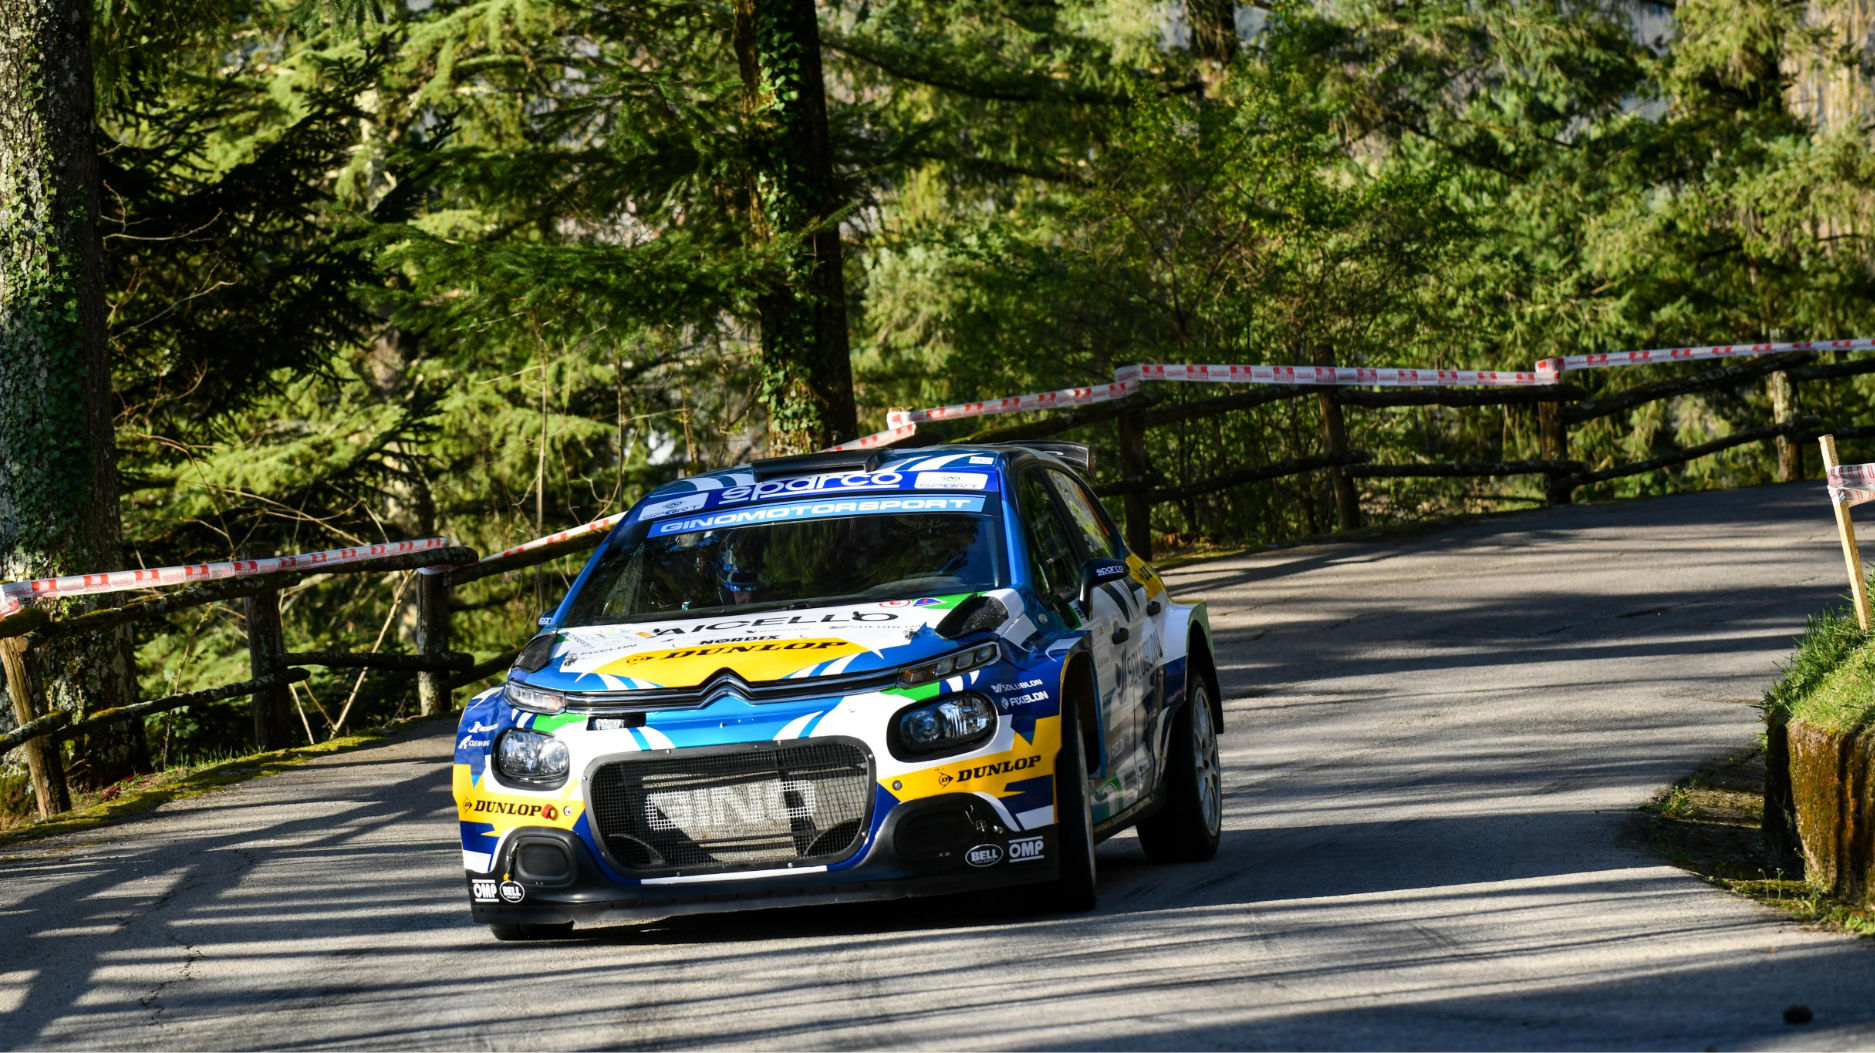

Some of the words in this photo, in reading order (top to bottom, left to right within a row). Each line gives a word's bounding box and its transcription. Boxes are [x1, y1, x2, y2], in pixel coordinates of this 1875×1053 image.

[719, 472, 903, 501] sparco
[660, 499, 971, 533] GINOMOTORSPORT
[1096, 565, 1124, 577] sparco
[699, 634, 781, 646] NORDIX
[659, 642, 849, 660] DUNLOP
[1001, 679, 1043, 691] SOLUBLON
[1009, 691, 1049, 707] FIXELON
[956, 755, 1041, 783] DUNLOP
[474, 800, 542, 817] DUNLOP
[971, 848, 998, 862] BELL
[1009, 839, 1044, 858] OMP
[473, 883, 498, 898] OMP
[502, 886, 521, 897] BELL
